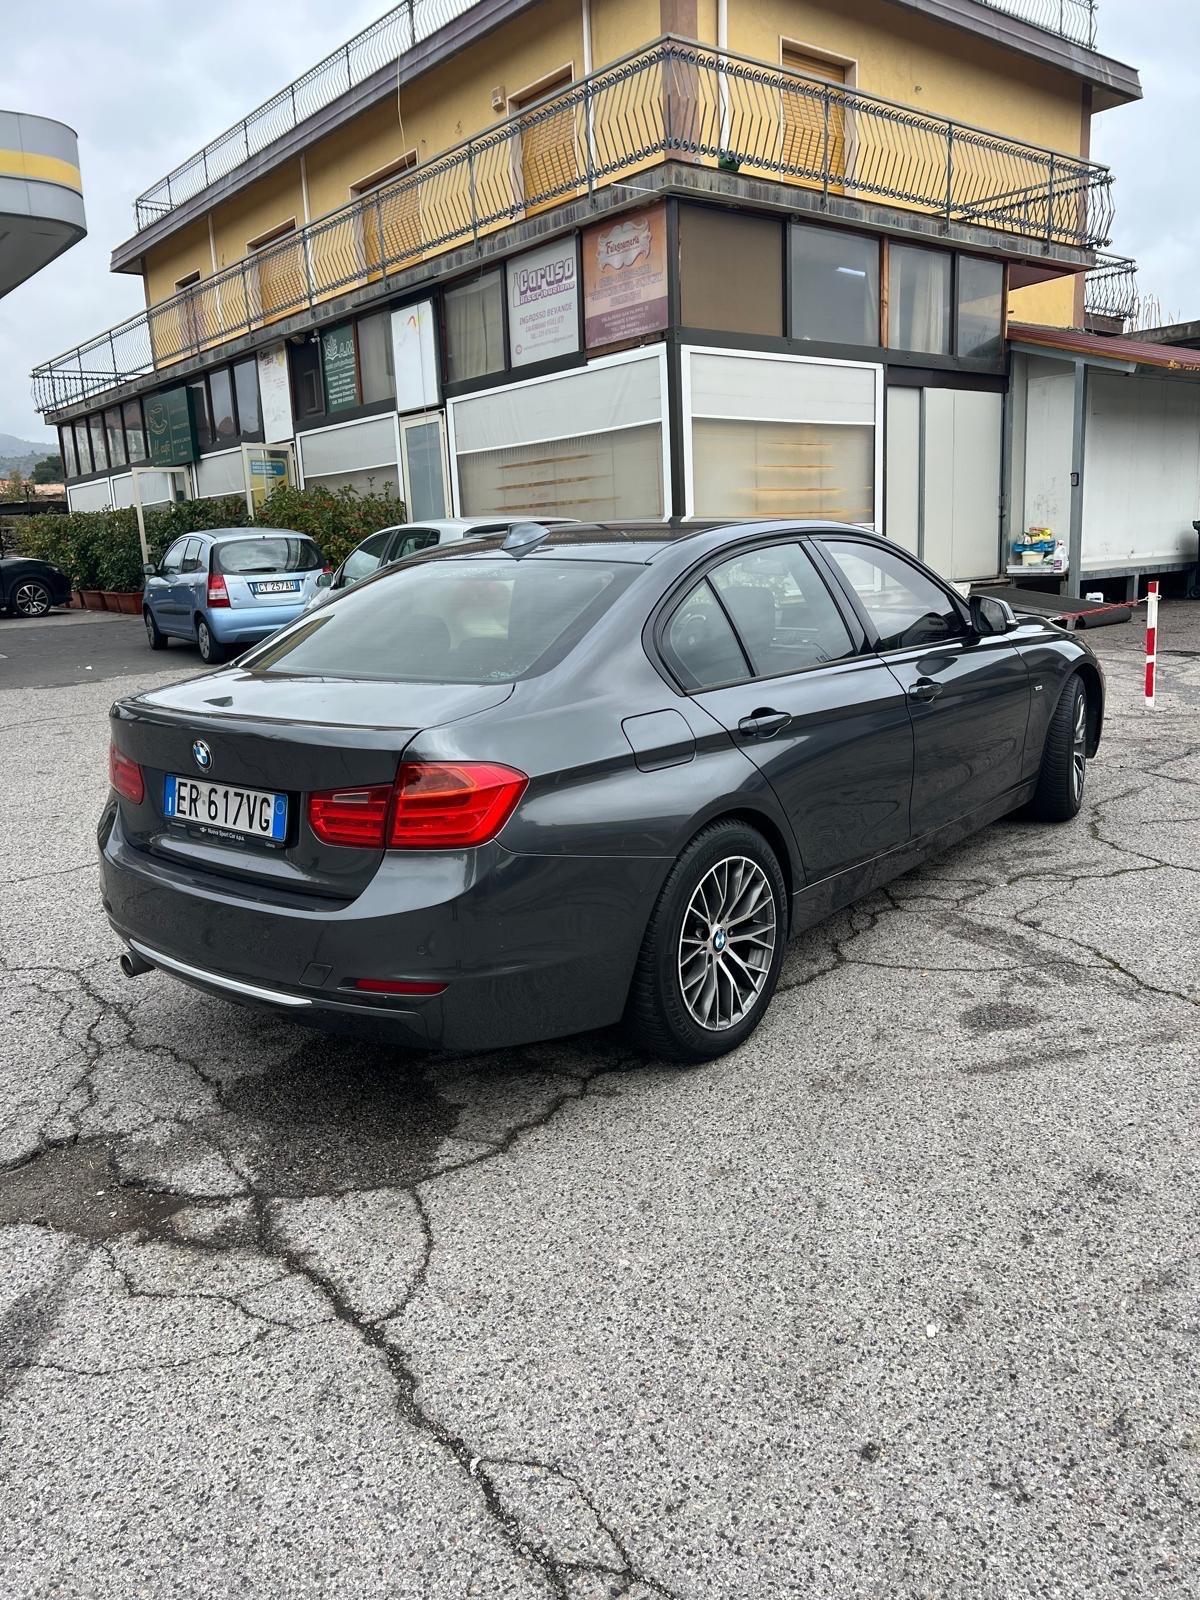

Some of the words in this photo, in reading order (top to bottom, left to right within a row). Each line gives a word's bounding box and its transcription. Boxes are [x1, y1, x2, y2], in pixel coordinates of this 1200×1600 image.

[519, 257, 574, 296] Caruso
[547, 302, 573, 317] BEVANDE
[176, 781, 200, 818] ER
[207, 787, 271, 832] 617VG
